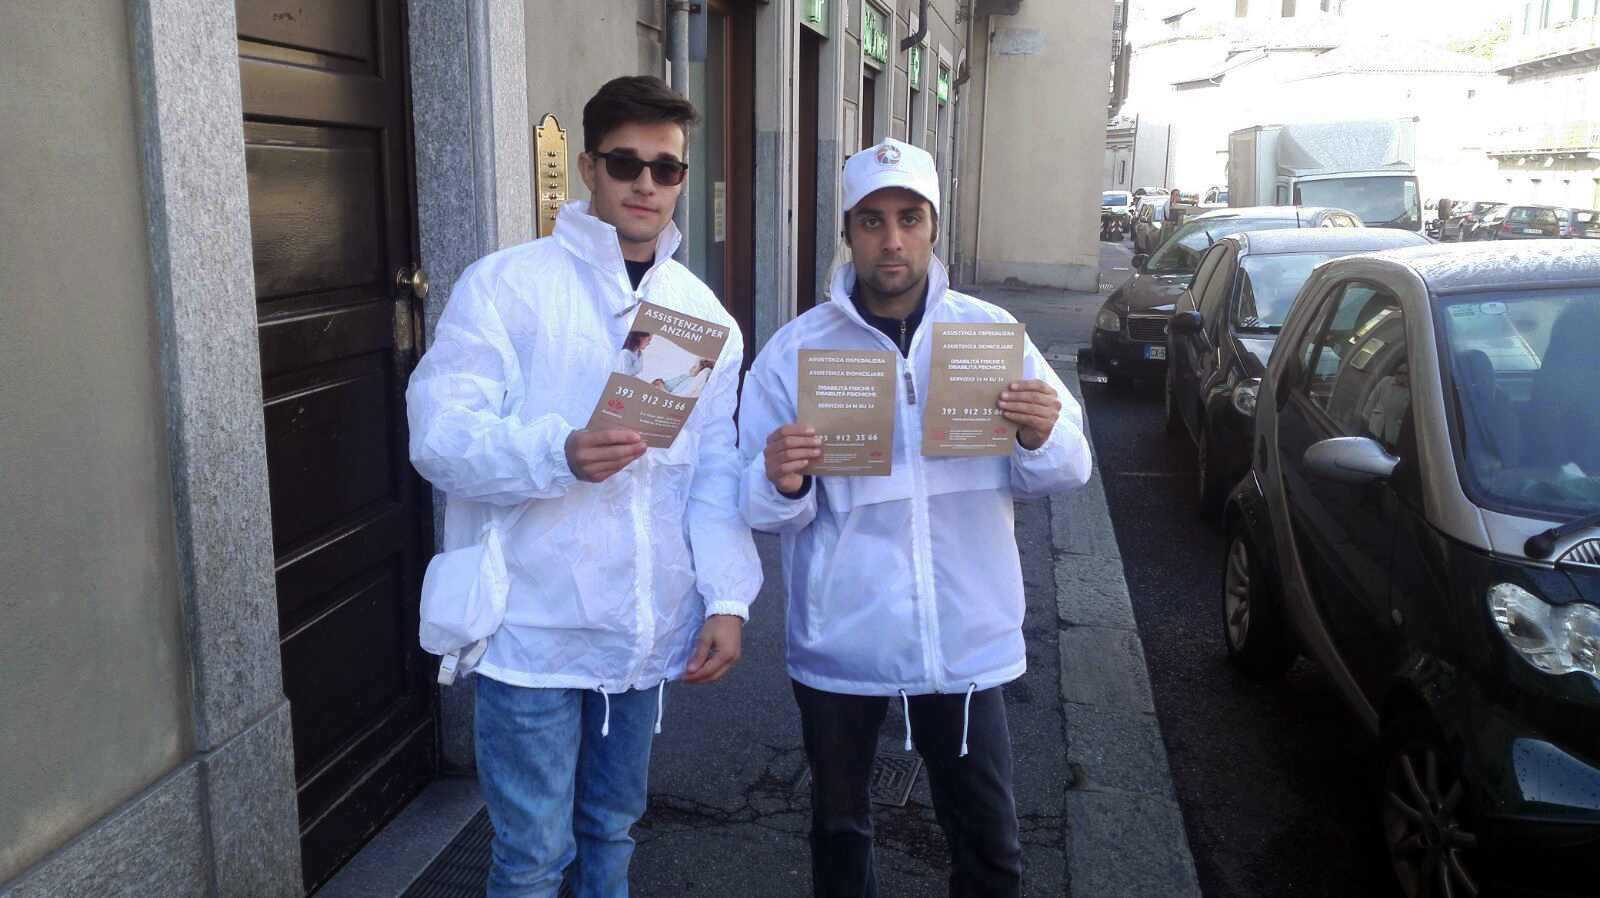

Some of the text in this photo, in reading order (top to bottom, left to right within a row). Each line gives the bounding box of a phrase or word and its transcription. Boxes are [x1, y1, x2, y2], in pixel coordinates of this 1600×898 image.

[644, 308, 724, 339] ASSISTENZA PER
[659, 324, 702, 343] ANZIANI
[615, 386, 634, 399] 393
[641, 394, 659, 405] 912
[941, 408, 956, 416] 393
[963, 408, 978, 416] 912
